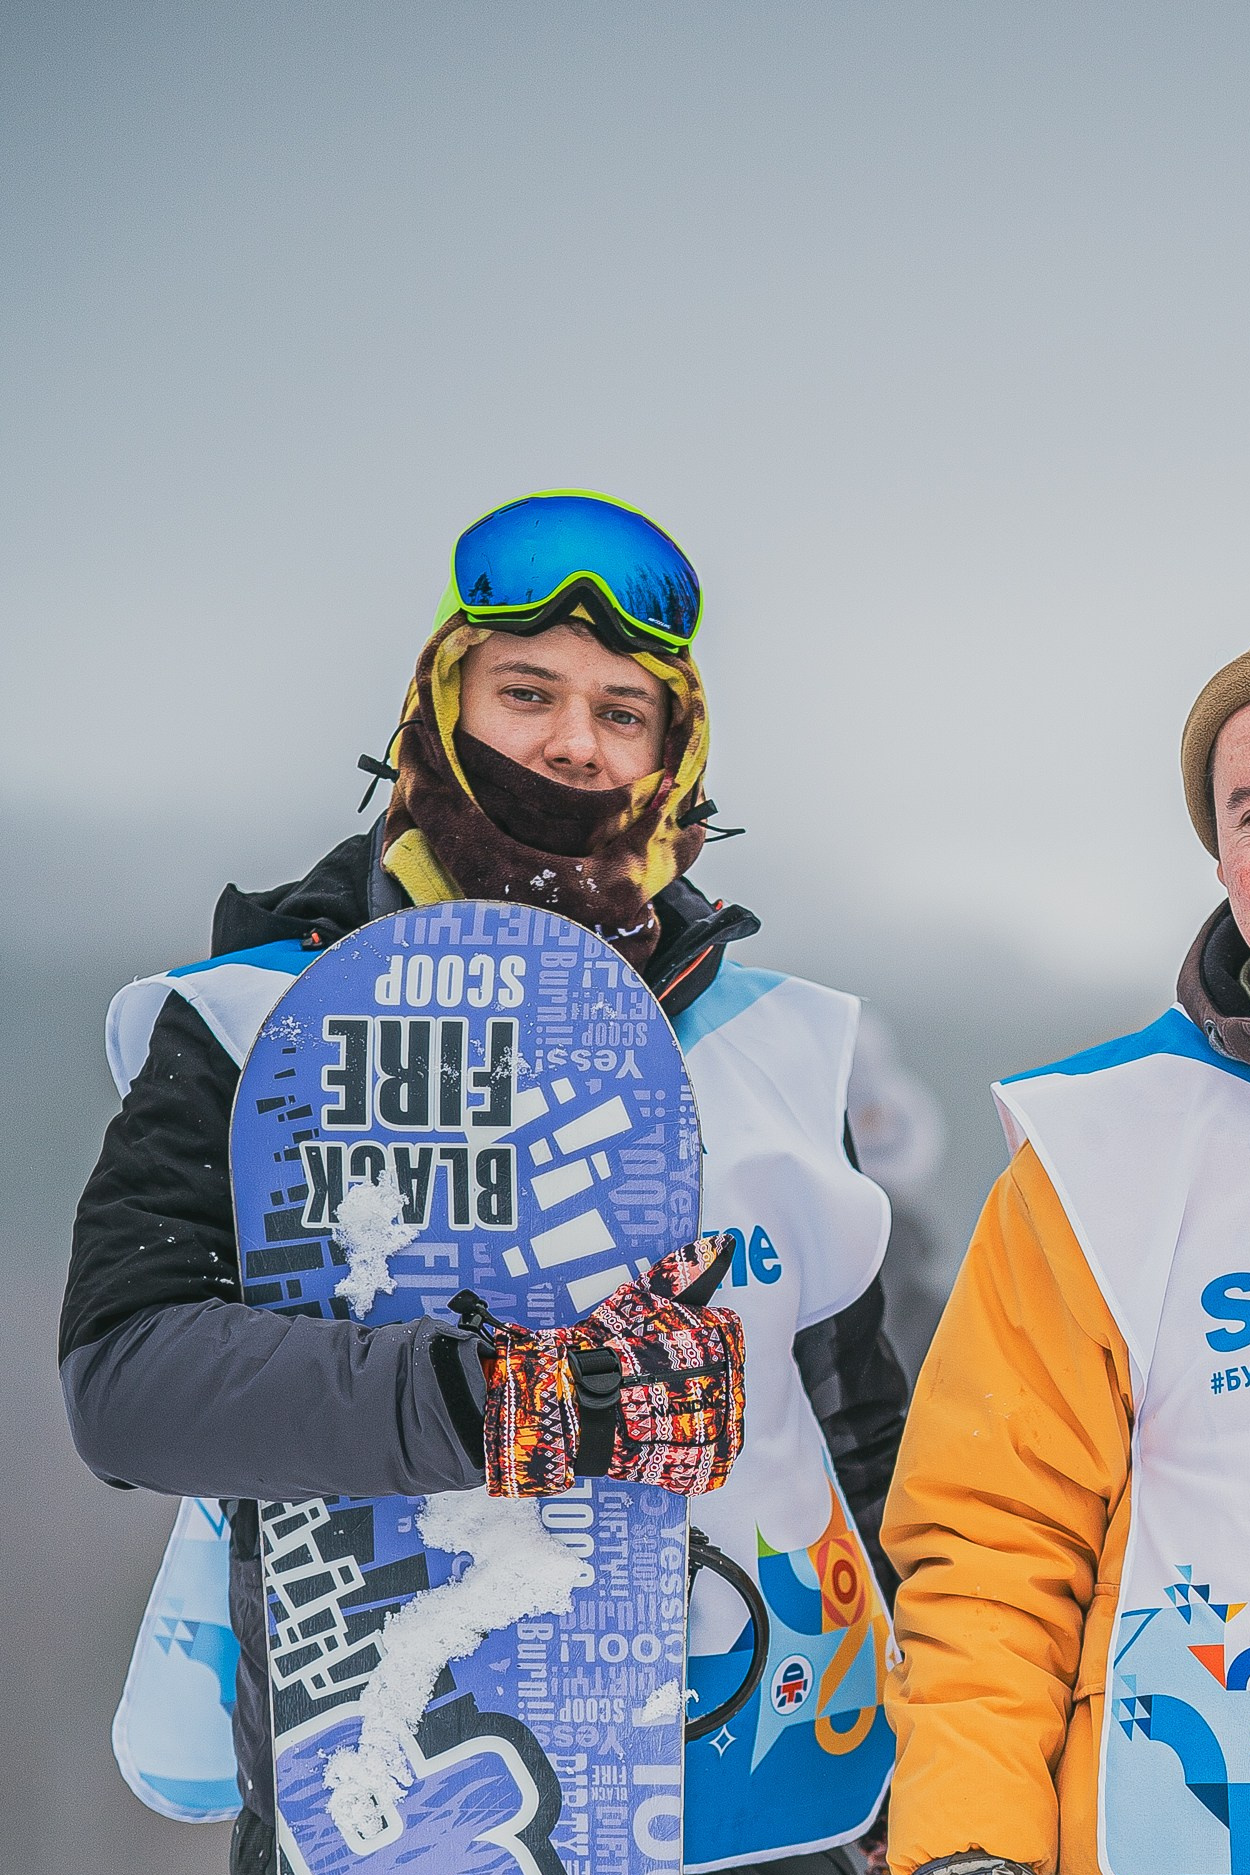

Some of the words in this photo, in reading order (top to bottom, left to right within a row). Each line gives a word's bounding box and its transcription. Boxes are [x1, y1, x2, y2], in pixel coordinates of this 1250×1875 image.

[375, 953, 526, 1008] SCOOP
[581, 1022, 648, 1047] SCOOP
[320, 1015, 519, 1132] FIRE
[560, 1633, 685, 1663] COOL!
[516, 1622, 556, 1722] Burn!!
[559, 1698, 625, 1723] SCOOP
